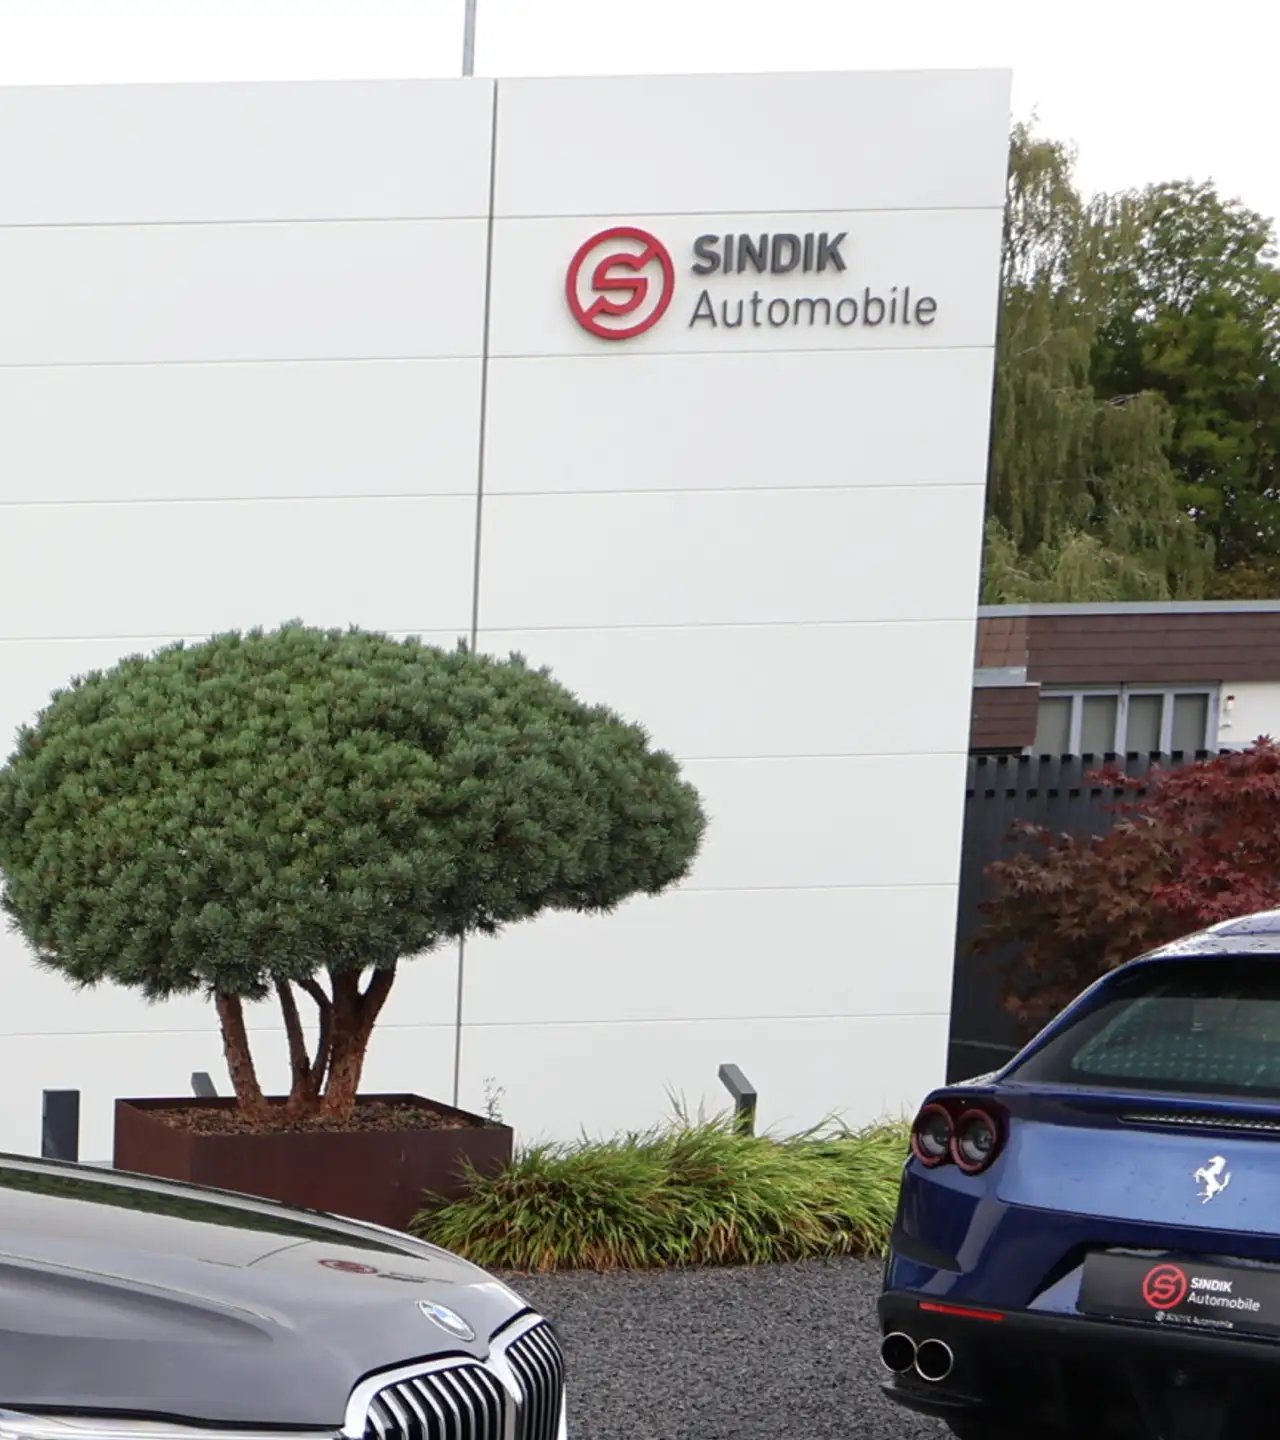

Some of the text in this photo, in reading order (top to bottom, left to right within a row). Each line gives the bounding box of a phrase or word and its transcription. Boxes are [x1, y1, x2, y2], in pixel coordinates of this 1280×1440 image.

[691, 232, 848, 274] SINDIK
[689, 287, 938, 329] Automobile
[1190, 1277, 1233, 1293] SINDIK
[1187, 1292, 1261, 1312] Automobile
